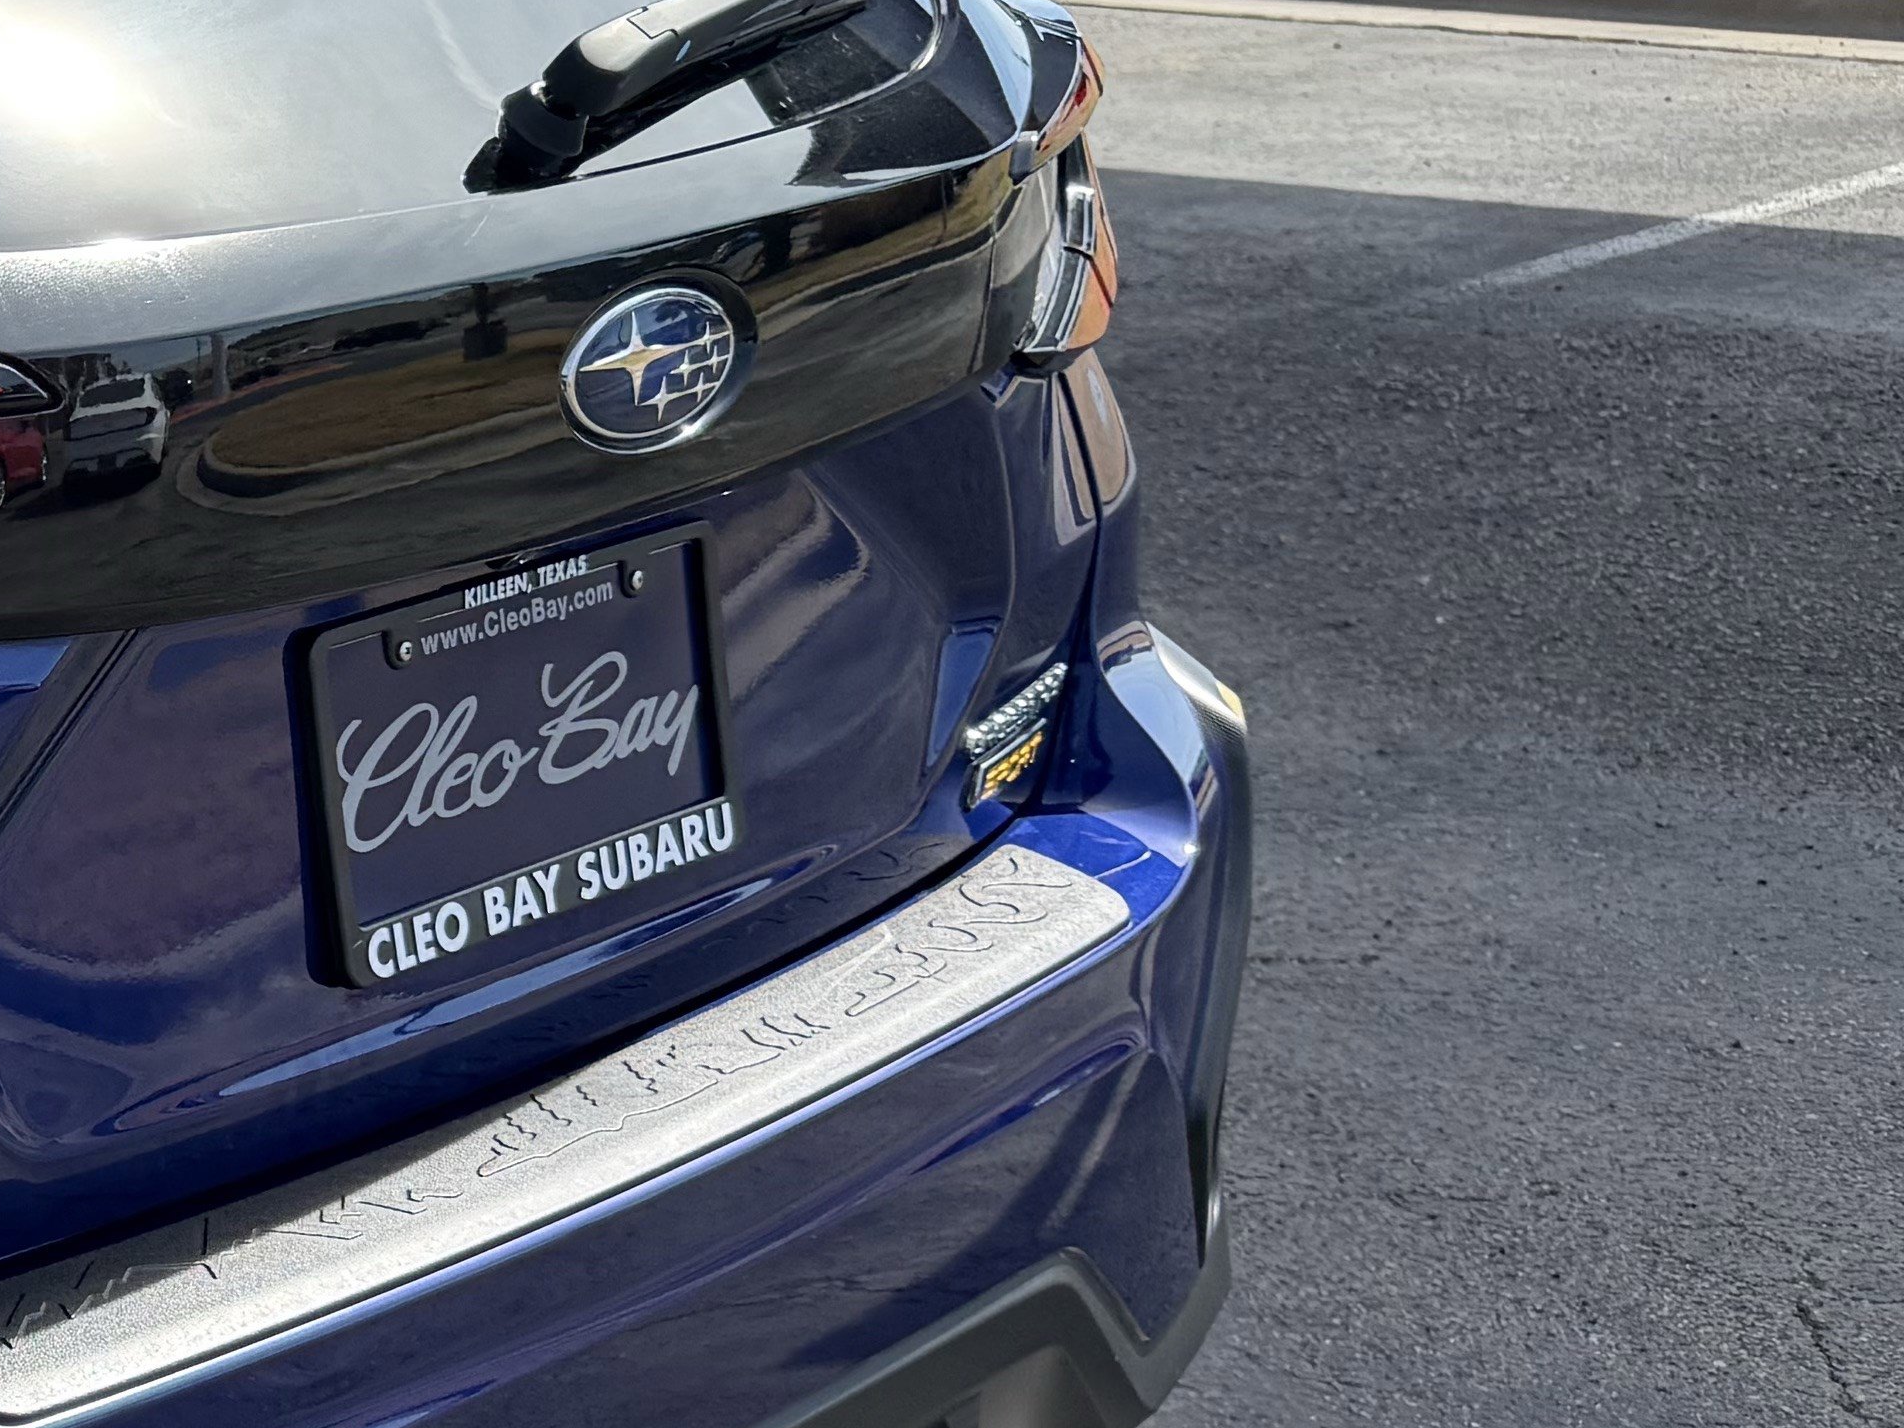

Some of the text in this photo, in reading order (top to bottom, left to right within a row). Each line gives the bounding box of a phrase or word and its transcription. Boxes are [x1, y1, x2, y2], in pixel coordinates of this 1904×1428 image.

[420, 581, 614, 656] www.CleoBay.com
[464, 554, 588, 610] KILLEEN, TEXAS
[335, 650, 699, 854] Cleo Bay
[367, 801, 735, 979] CLEO BAY SUBARU
